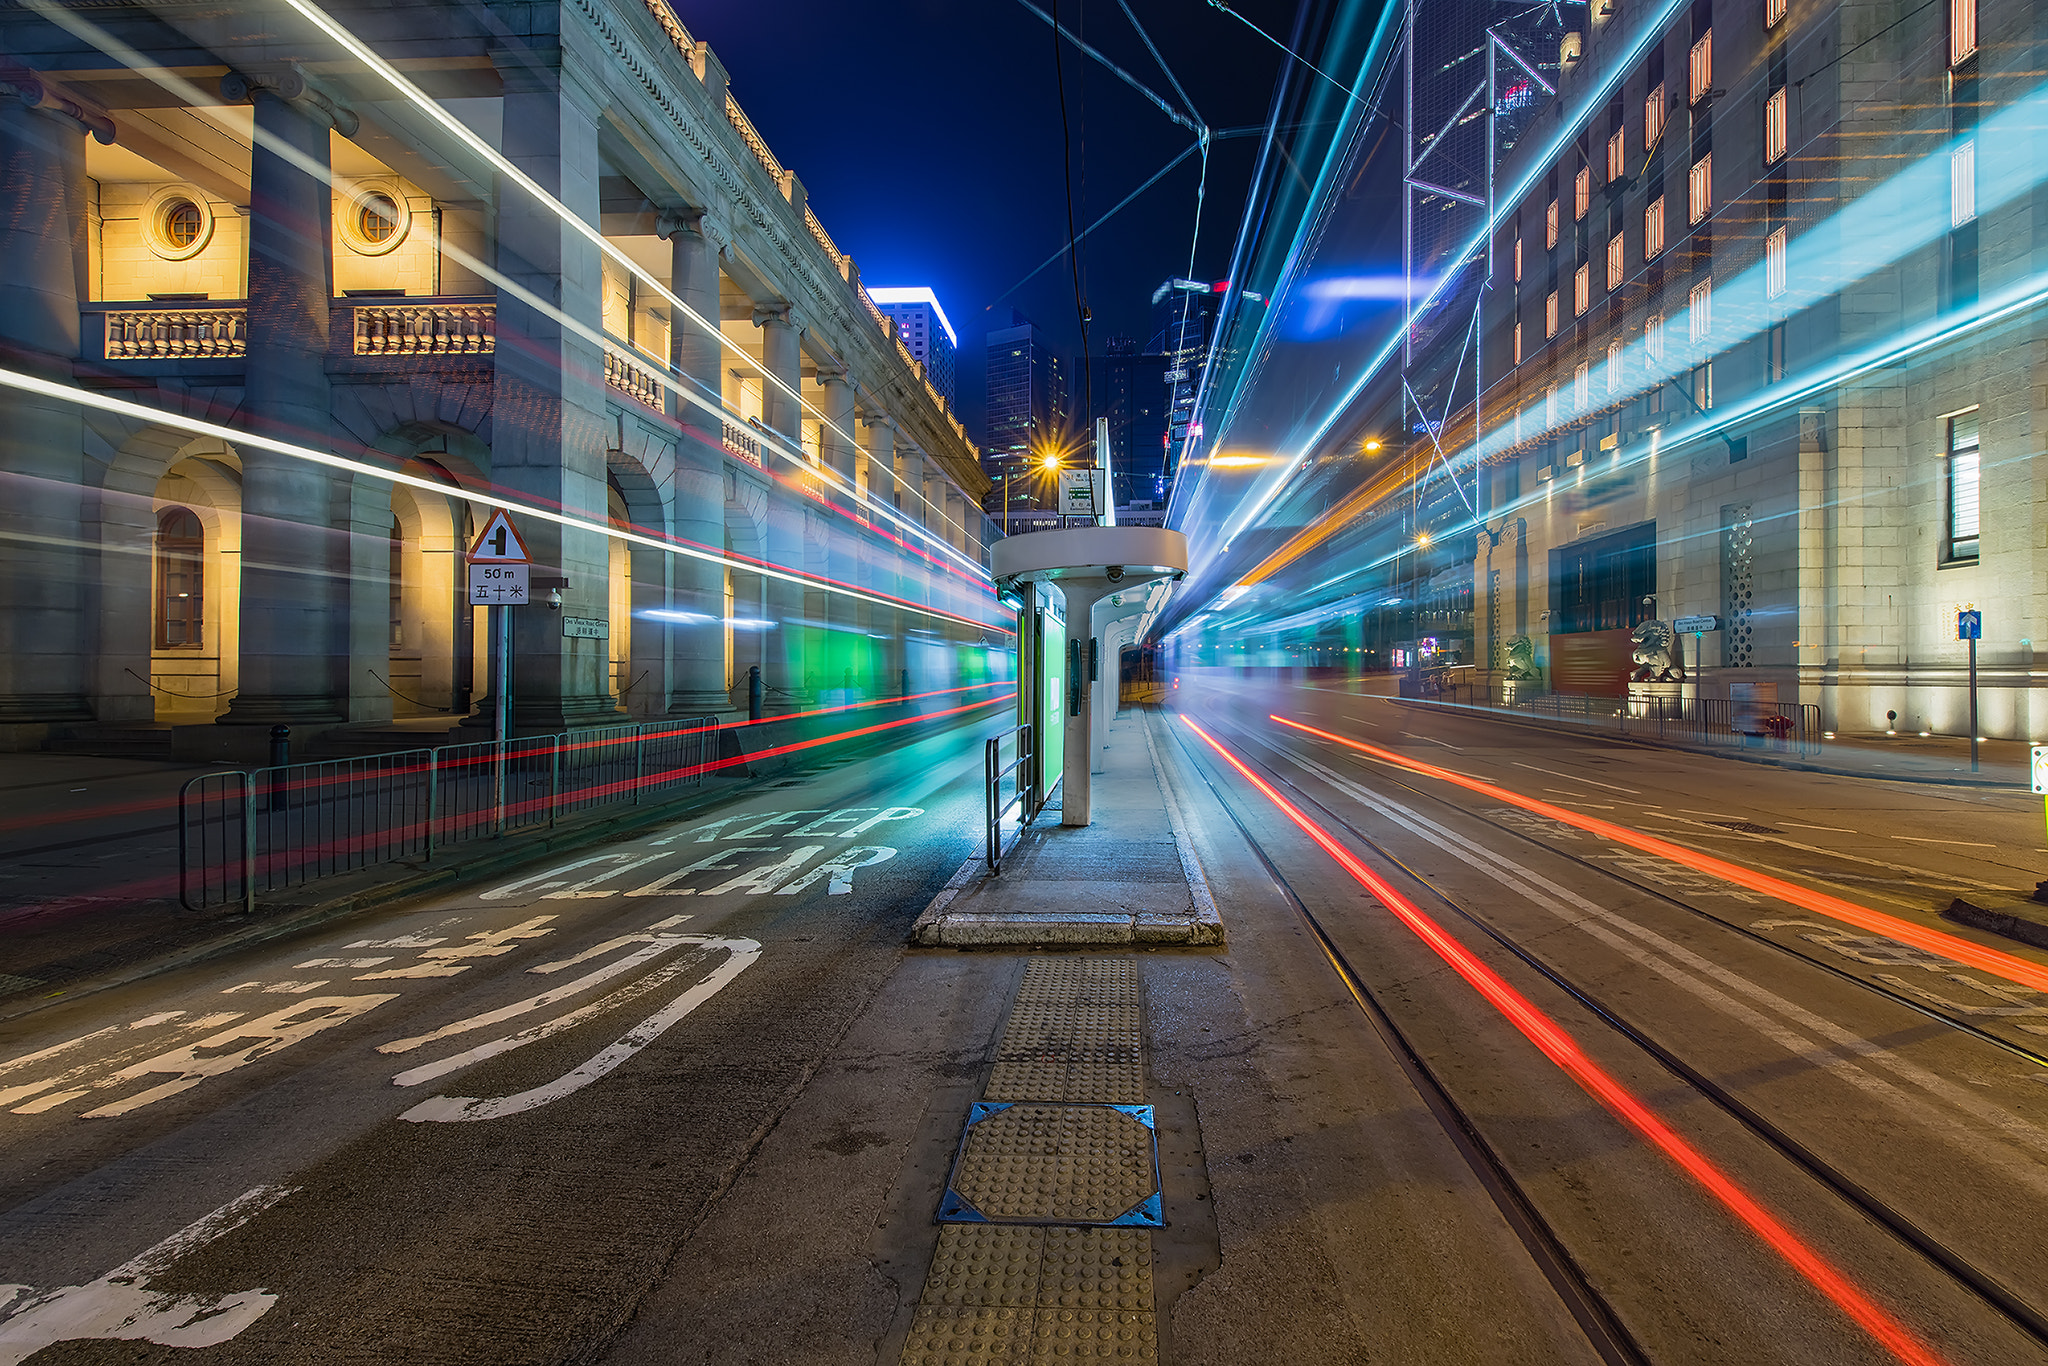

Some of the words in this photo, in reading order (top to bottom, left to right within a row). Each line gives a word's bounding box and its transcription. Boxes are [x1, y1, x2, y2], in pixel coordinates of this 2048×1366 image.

[484, 568, 501, 579] 50
[504, 571, 514, 579] m
[476, 585, 523, 600] 五十米
[648, 807, 926, 846] KEEP
[479, 845, 897, 900] CLEAR
